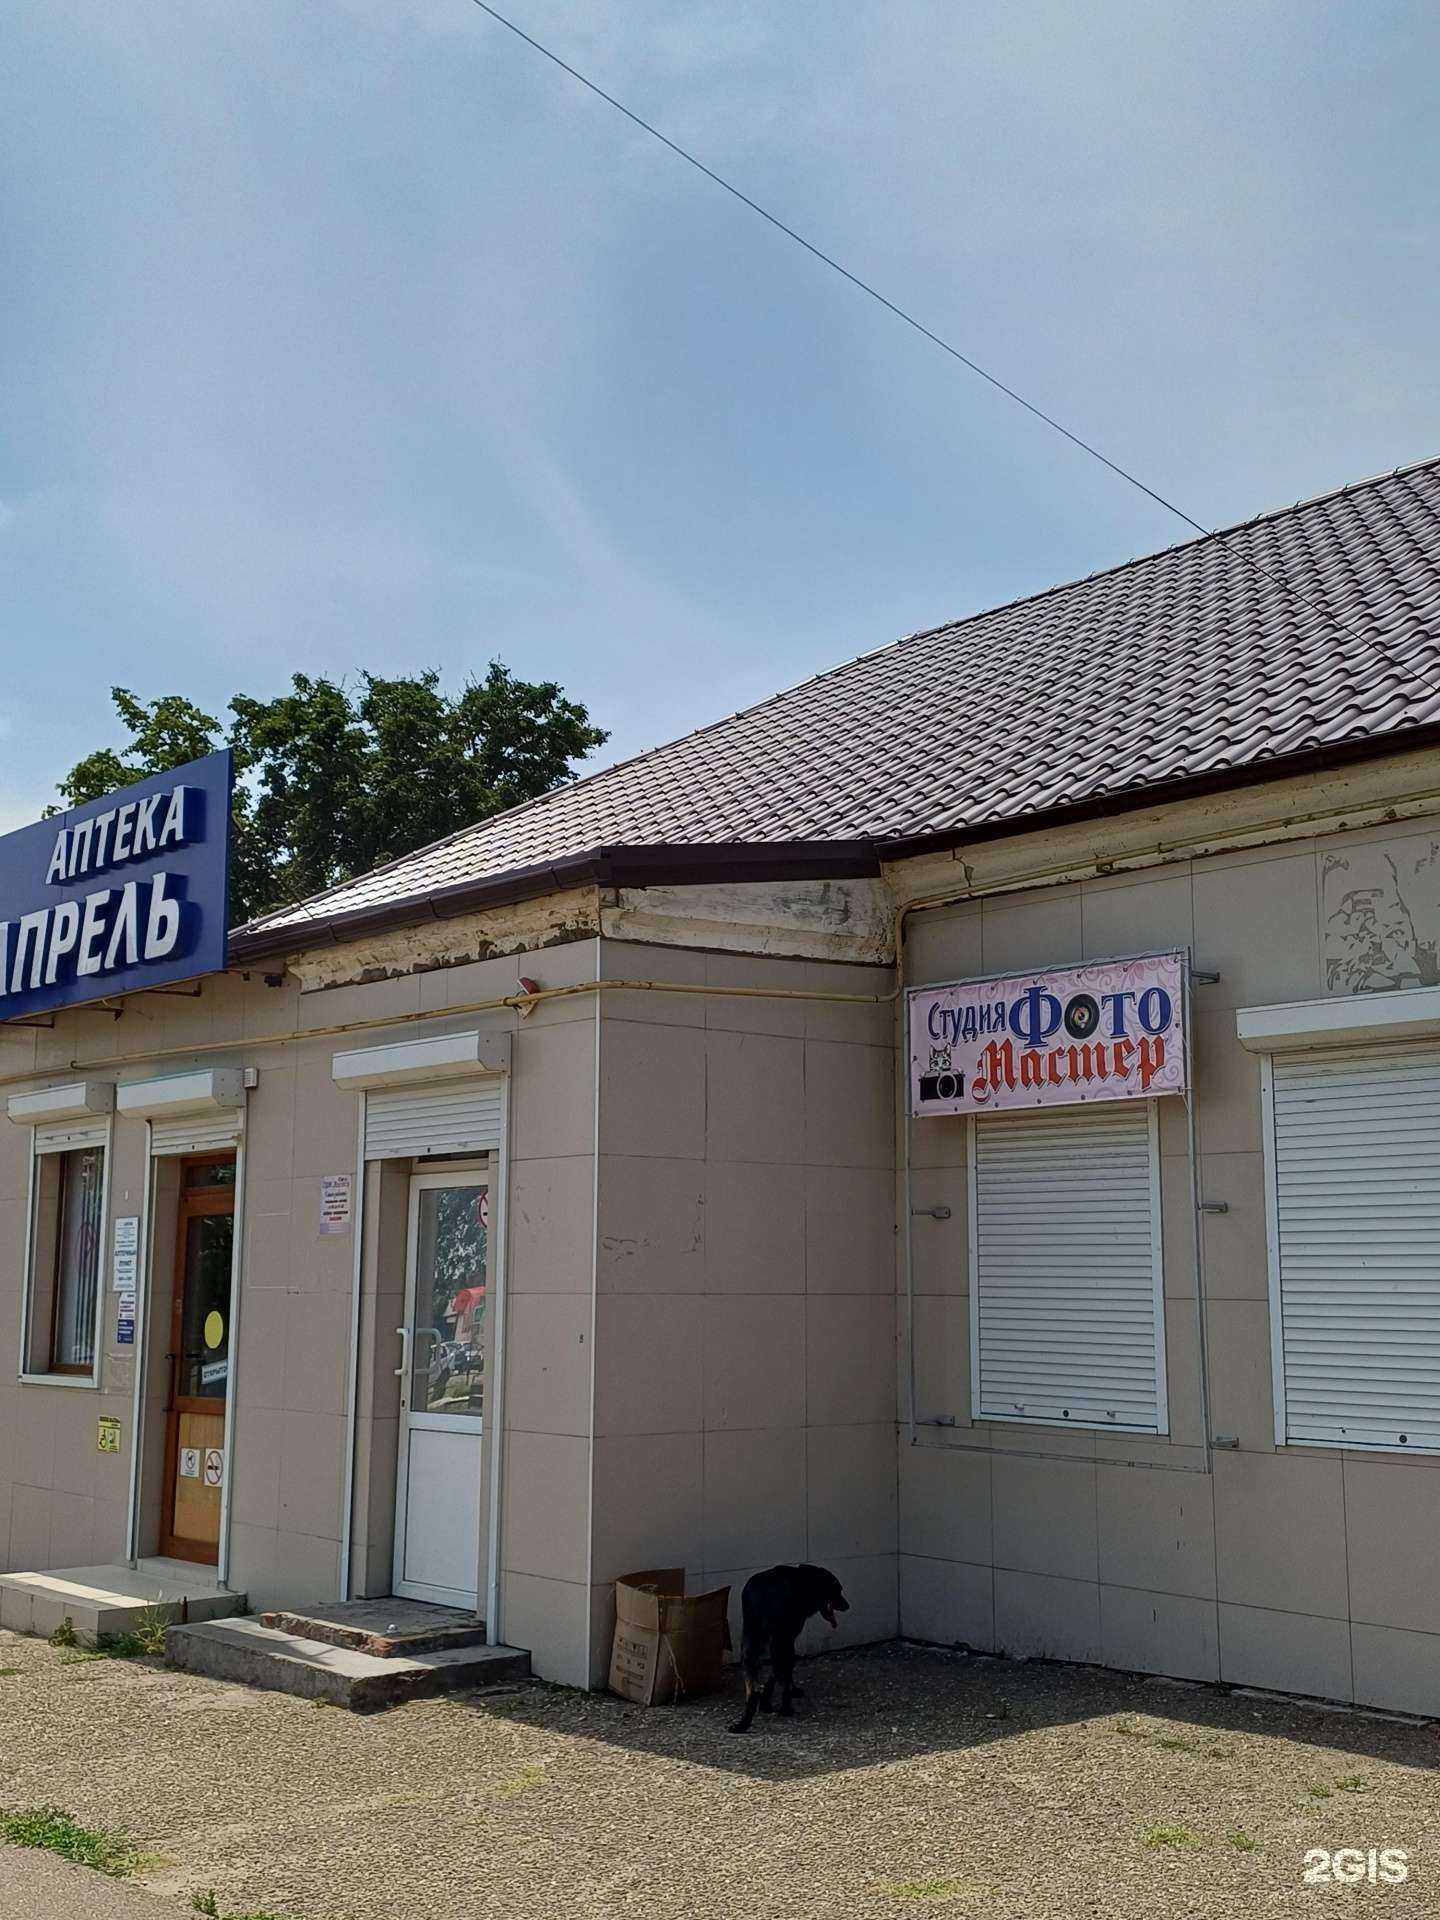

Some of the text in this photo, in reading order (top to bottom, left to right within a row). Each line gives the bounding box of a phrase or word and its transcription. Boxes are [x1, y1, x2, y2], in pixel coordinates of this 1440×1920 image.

[45, 785, 185, 884] АПТЕКА
[927, 1000, 1007, 1048] Студия
[972, 1036, 1168, 1105] Мастер
